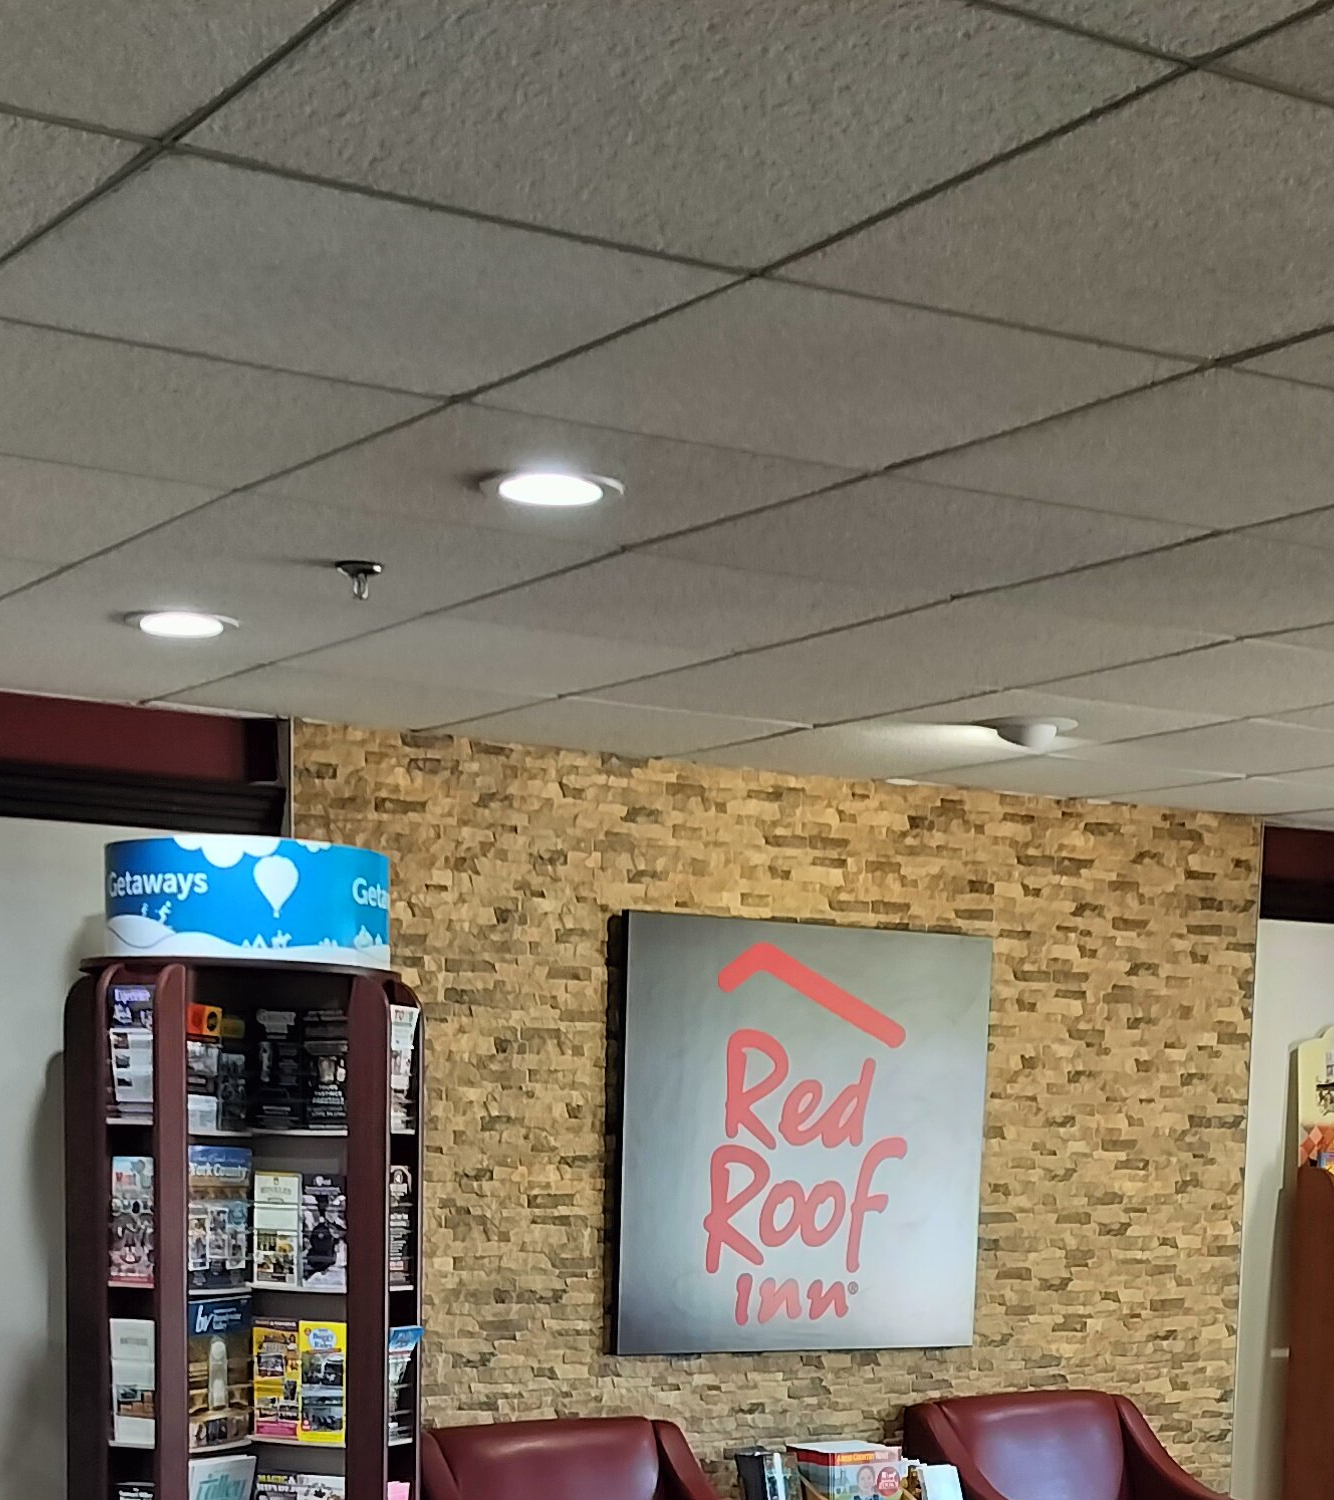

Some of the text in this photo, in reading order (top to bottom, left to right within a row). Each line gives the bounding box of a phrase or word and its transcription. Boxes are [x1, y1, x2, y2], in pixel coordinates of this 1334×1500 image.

[108, 871, 208, 901] Getaways
[725, 1028, 877, 1150] Red
[703, 1136, 908, 1274] Roof
